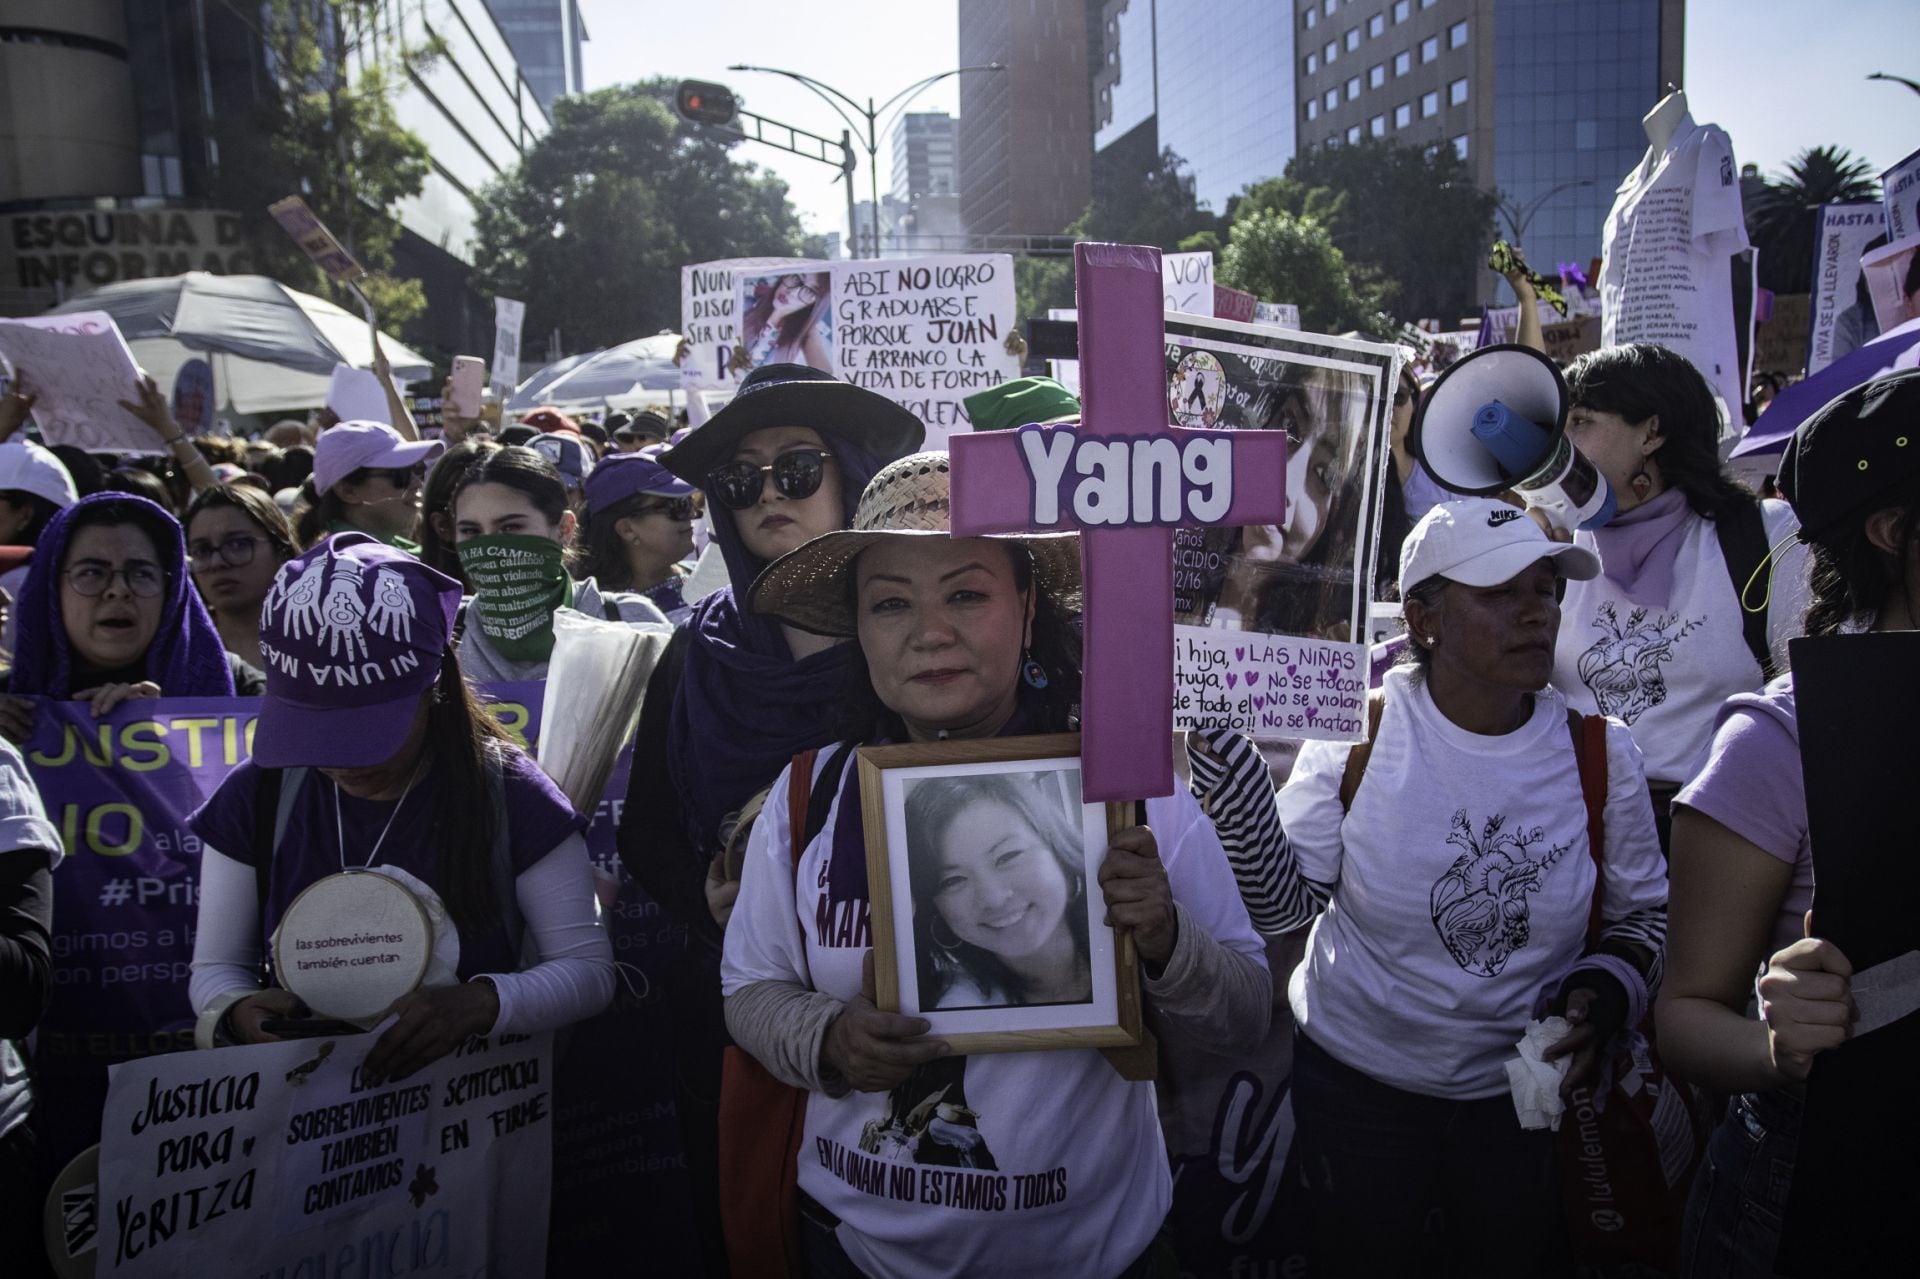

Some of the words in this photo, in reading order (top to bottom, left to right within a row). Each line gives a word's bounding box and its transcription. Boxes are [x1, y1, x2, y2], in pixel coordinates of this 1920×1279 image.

[12, 212, 197, 249] ESQUINA
[1826, 213, 1874, 227] HASTA
[1170, 255, 1210, 285] VOY
[1826, 231, 1840, 292] LLEVARON
[692, 269, 735, 297] NUN
[844, 270, 890, 296] ABI
[898, 266, 931, 291] NO
[693, 299, 734, 319] DISC
[839, 296, 979, 324] GRADUARSE
[1823, 293, 1835, 309] LA
[839, 324, 914, 346] PORQUE
[926, 314, 998, 345] JUAN
[1820, 311, 1833, 326] SE
[687, 323, 713, 346] SER
[841, 348, 859, 368] LE
[957, 348, 986, 367] LA
[844, 370, 895, 388] VIDA
[901, 371, 926, 389] DE
[930, 369, 1008, 390] FORMA
[1021, 430, 1233, 526] Yang
[1491, 510, 1519, 521] NIKE
[1176, 530, 1203, 547] años
[470, 547, 484, 558] HA
[500, 556, 544, 568] callando
[503, 569, 543, 582] violando
[390, 650, 420, 677] NI
[1189, 638, 1230, 672] hija,
[1250, 644, 1289, 665] LAS
[1298, 646, 1356, 670] NIÑAS
[307, 662, 385, 686] UNA
[1175, 665, 1224, 693] tuya,
[1268, 671, 1288, 690] No
[1292, 675, 1312, 690] se
[1316, 670, 1365, 693] tocan
[1172, 691, 1191, 710] de
[1195, 691, 1232, 713] todo
[1238, 693, 1252, 715] el
[1266, 691, 1287, 706] No
[1292, 694, 1309, 706] se
[1317, 692, 1363, 712] violan
[1262, 711, 1283, 728] No
[1287, 714, 1304, 728] se
[1308, 713, 1362, 733] matan
[156, 832, 171, 851] a
[816, 893, 873, 948] MAR
[53, 929, 150, 958] gimos
[296, 939, 313, 950] las
[315, 933, 403, 950] sobrevivientes
[297, 957, 348, 970] también
[350, 953, 400, 967] cuentan
[100, 961, 191, 989] persp
[287, 1084, 431, 1145] SOBREVIVIENTES
[441, 1119, 469, 1154] EN
[487, 1092, 548, 1137] FIRME
[321, 1121, 400, 1174] TAMBIÉN
[1572, 1087, 1614, 1201] lululemon
[304, 1157, 404, 1215] CONTAMOS
[816, 1135, 833, 1172] EN
[834, 1142, 845, 1181] LA
[846, 1150, 886, 1197] UNAM
[889, 1165, 916, 1202] NO
[919, 1169, 1008, 1211] ESTAMOS
[1013, 1166, 1067, 1210] TODXS
